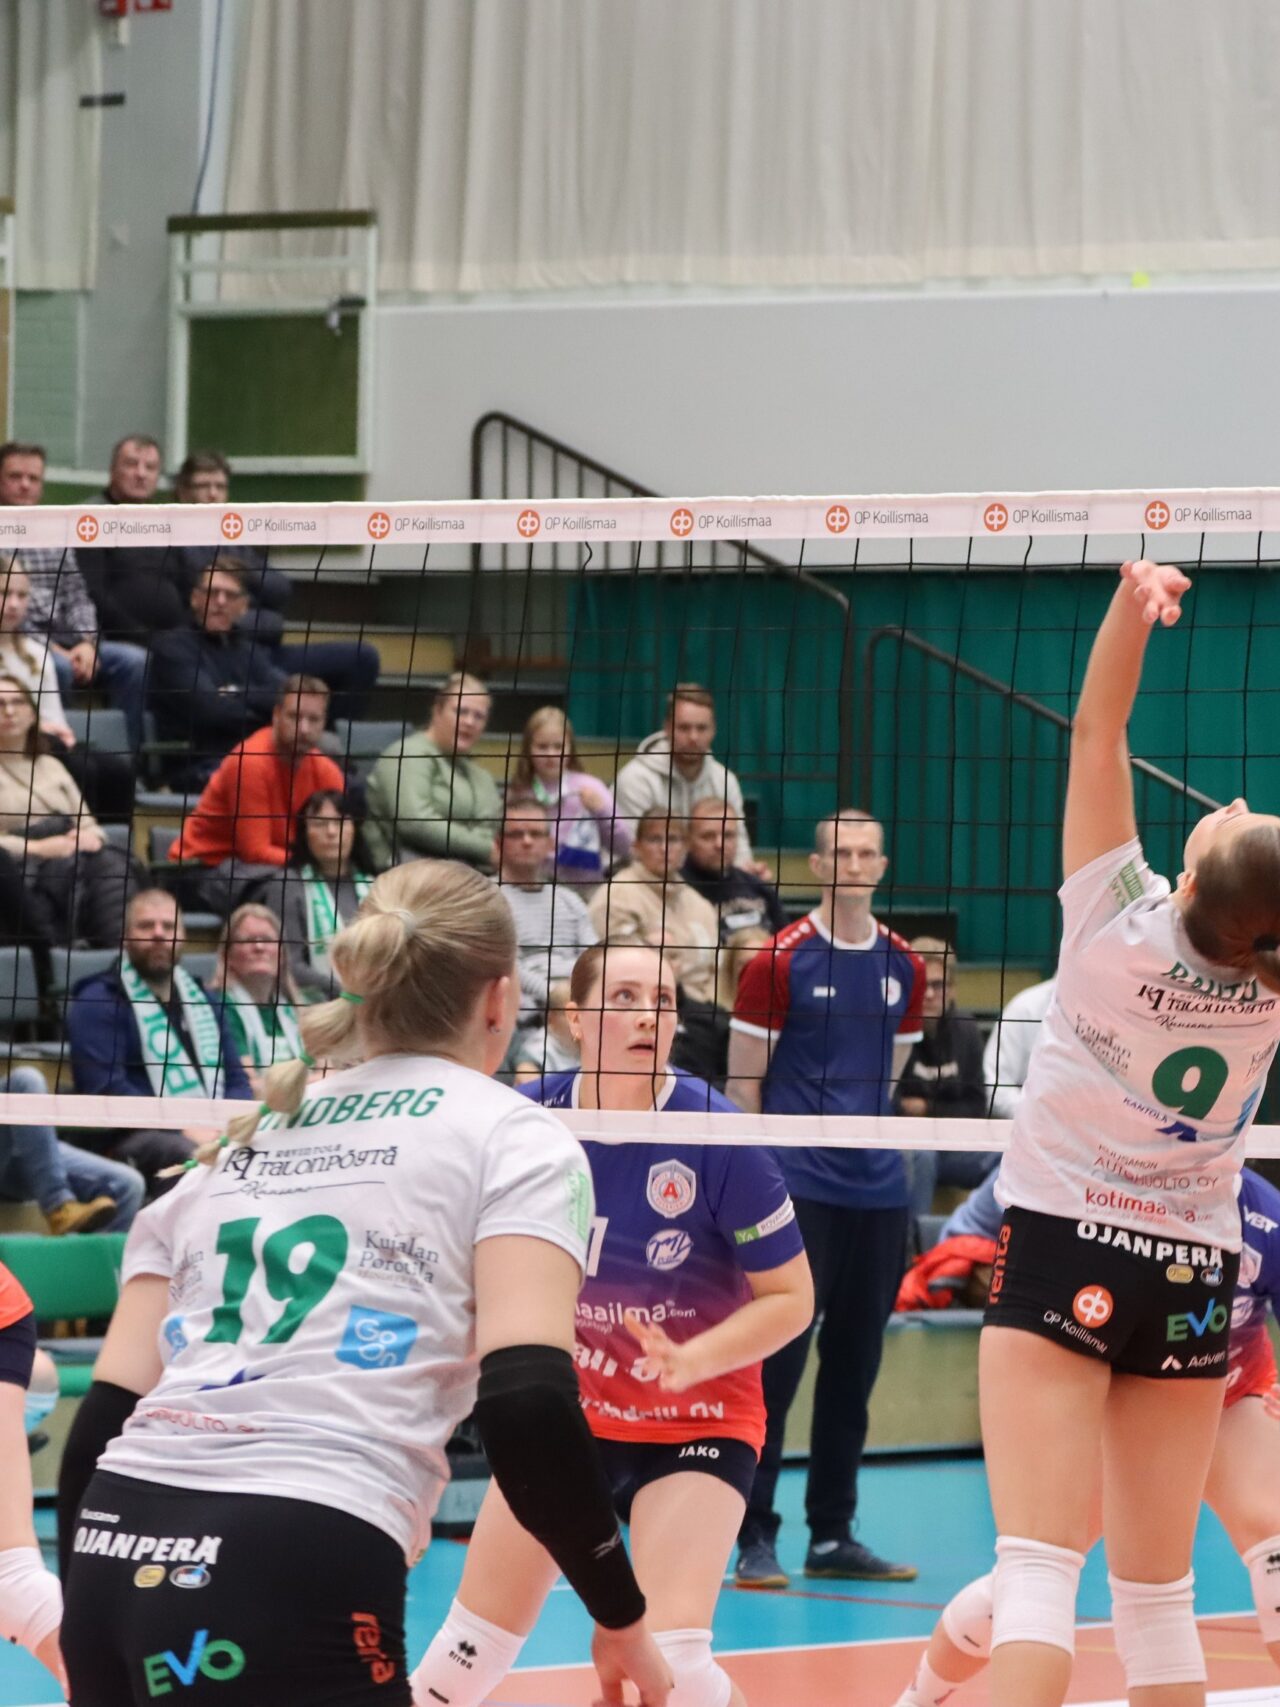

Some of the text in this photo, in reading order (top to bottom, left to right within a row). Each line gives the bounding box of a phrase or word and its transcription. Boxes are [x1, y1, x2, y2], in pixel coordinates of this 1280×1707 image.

[545, 514, 617, 531] OP Koillismaa
[698, 513, 772, 529] OP Koillismaa
[854, 509, 929, 525] OP Koillismaa
[1012, 507, 1089, 524] OP Koillismaa
[1174, 506, 1253, 522] OP Koillismaa
[102, 519, 172, 535] OP Koillismaa
[247, 516, 317, 534] OP Koillismaa
[394, 515, 466, 532] OP Koillismaa
[1152, 1045, 1229, 1121] 9
[1243, 1206, 1279, 1234] VBT
[365, 1230, 439, 1263] Kujalan
[988, 1224, 1012, 1304] renta
[204, 1214, 349, 1345] 19
[1043, 1309, 1062, 1325] OP
[1166, 1298, 1230, 1343] EVO
[1187, 1350, 1226, 1370] Adven
[678, 1445, 720, 1460] JAKO
[143, 1629, 246, 1697] EVO
